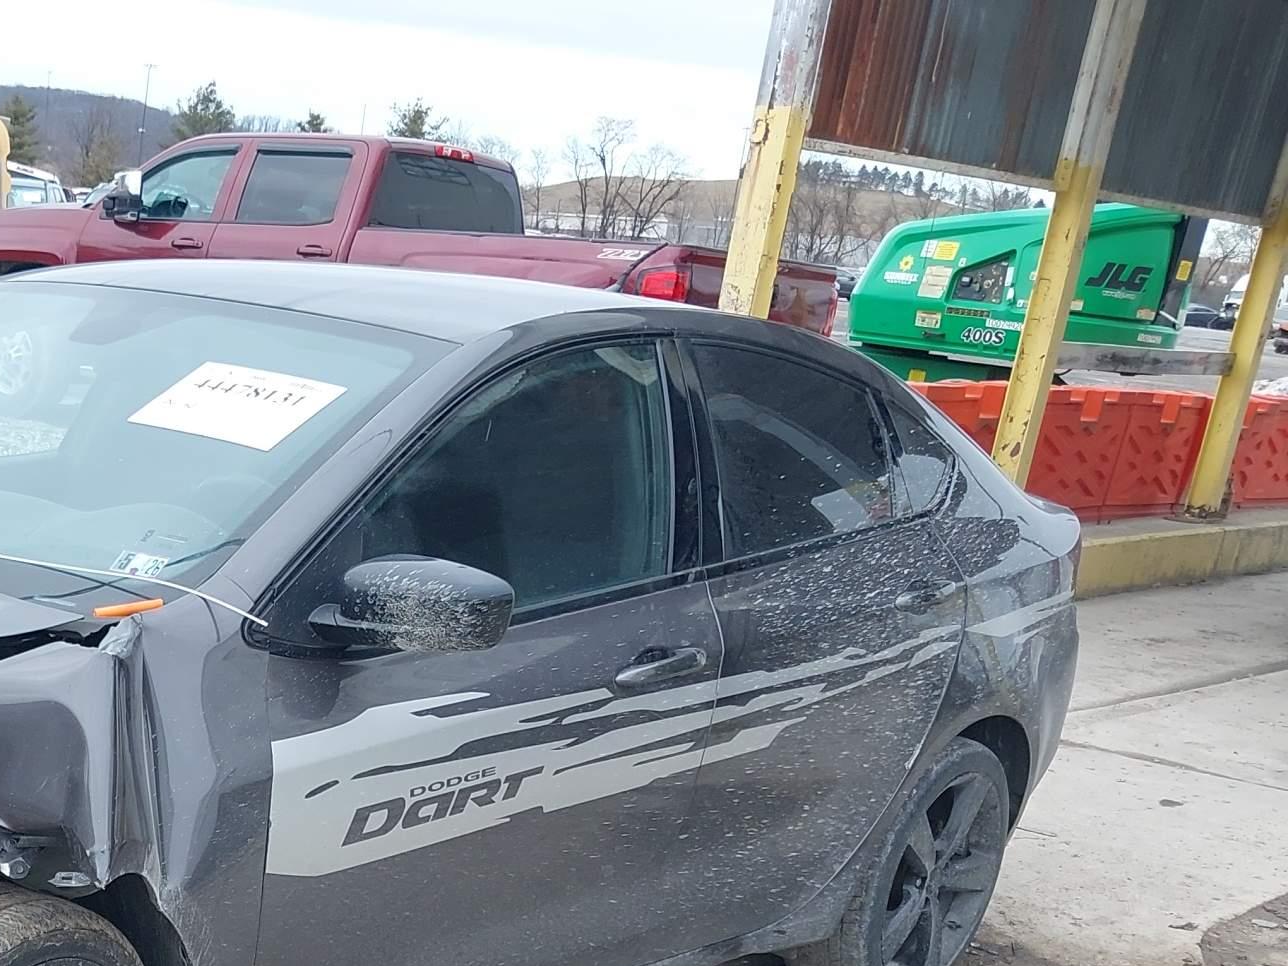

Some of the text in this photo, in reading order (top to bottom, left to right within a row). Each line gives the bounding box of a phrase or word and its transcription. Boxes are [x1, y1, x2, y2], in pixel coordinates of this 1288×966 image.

[1084, 261, 1153, 292] JLG
[960, 326, 1006, 346] 400S
[194, 378, 307, 407] 44478131
[409, 766, 497, 798] DODGE
